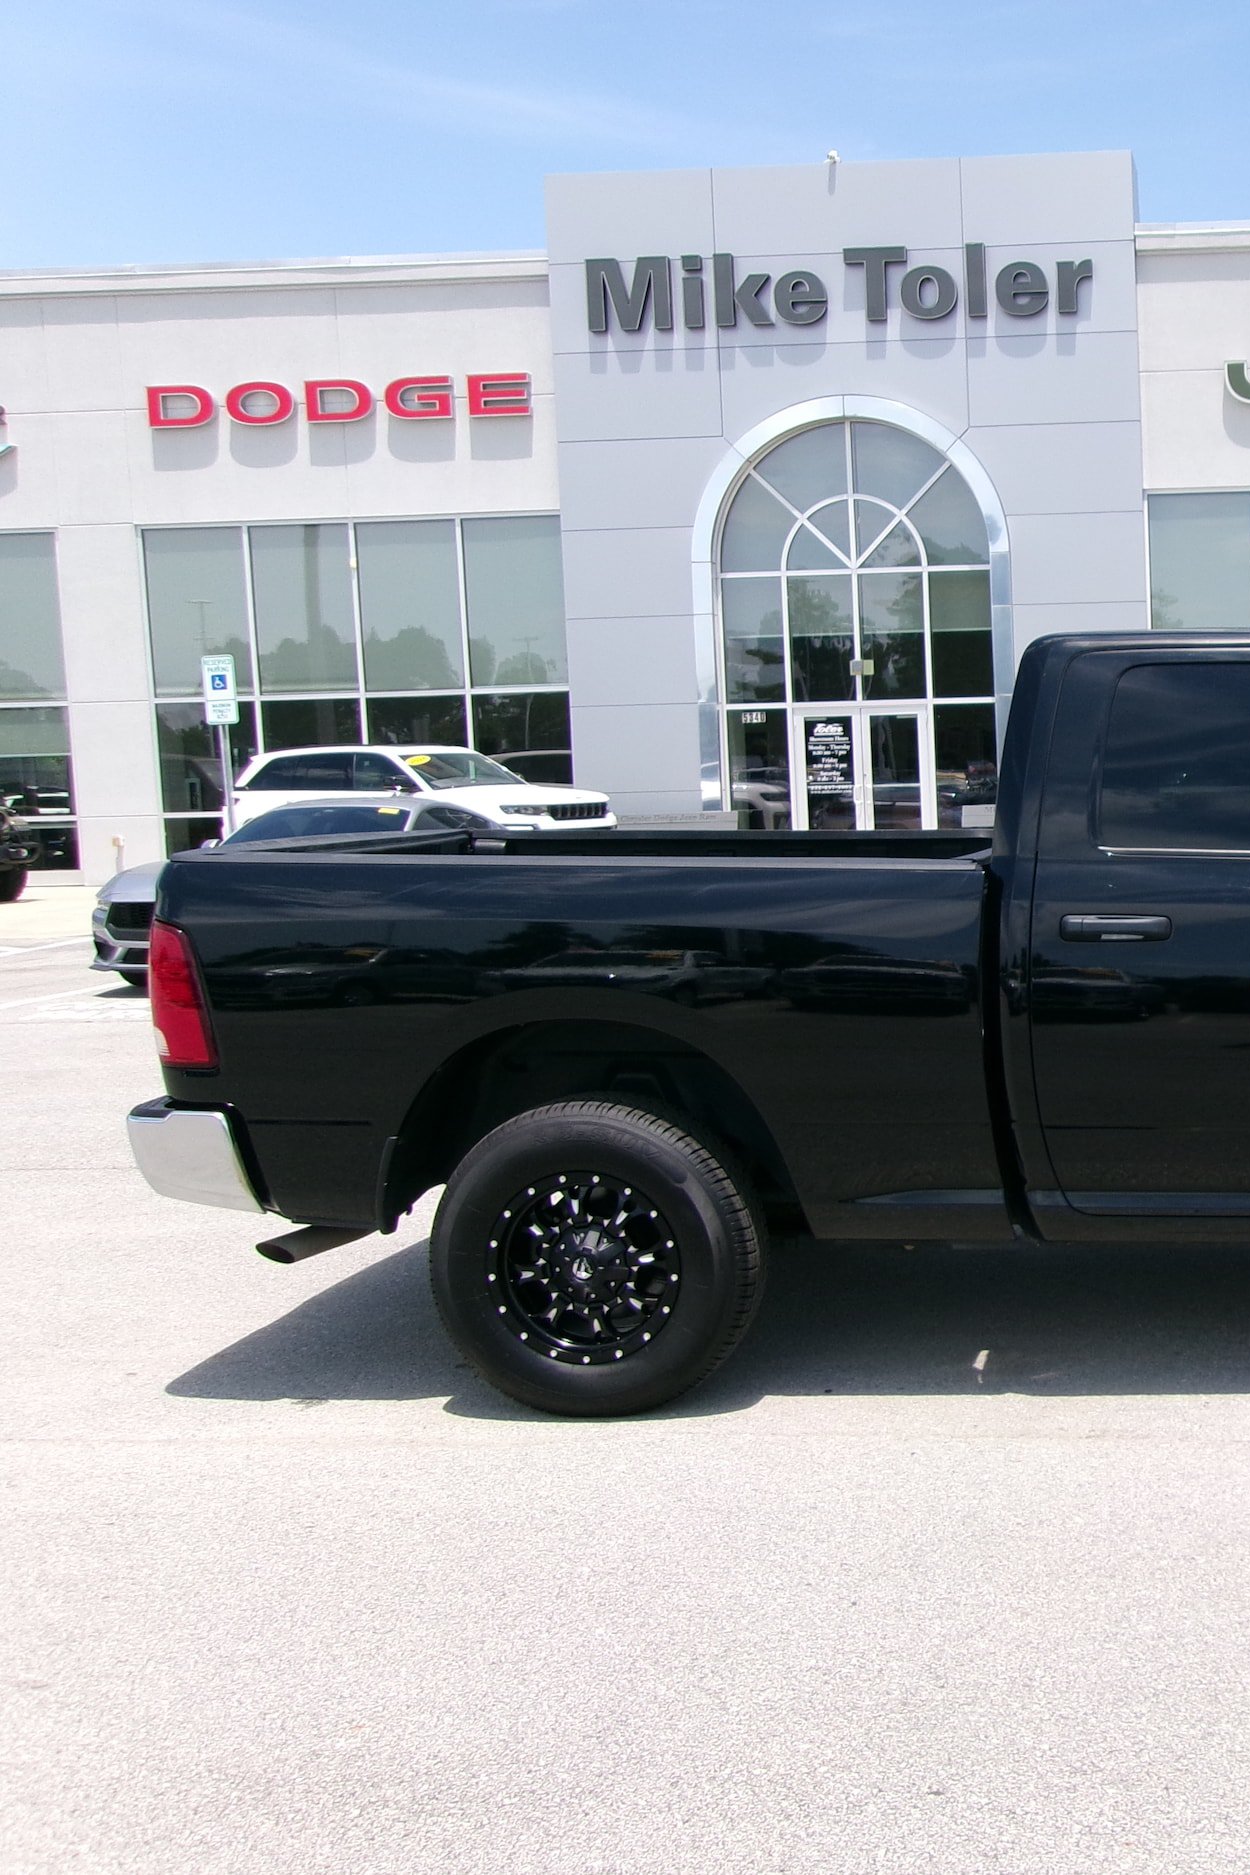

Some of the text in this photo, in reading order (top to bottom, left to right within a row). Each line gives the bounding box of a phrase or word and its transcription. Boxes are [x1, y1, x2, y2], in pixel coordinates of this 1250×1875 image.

[584, 242, 1094, 333] Mike Toler
[144, 372, 533, 429] DODGE
[742, 711, 766, 723] 5340
